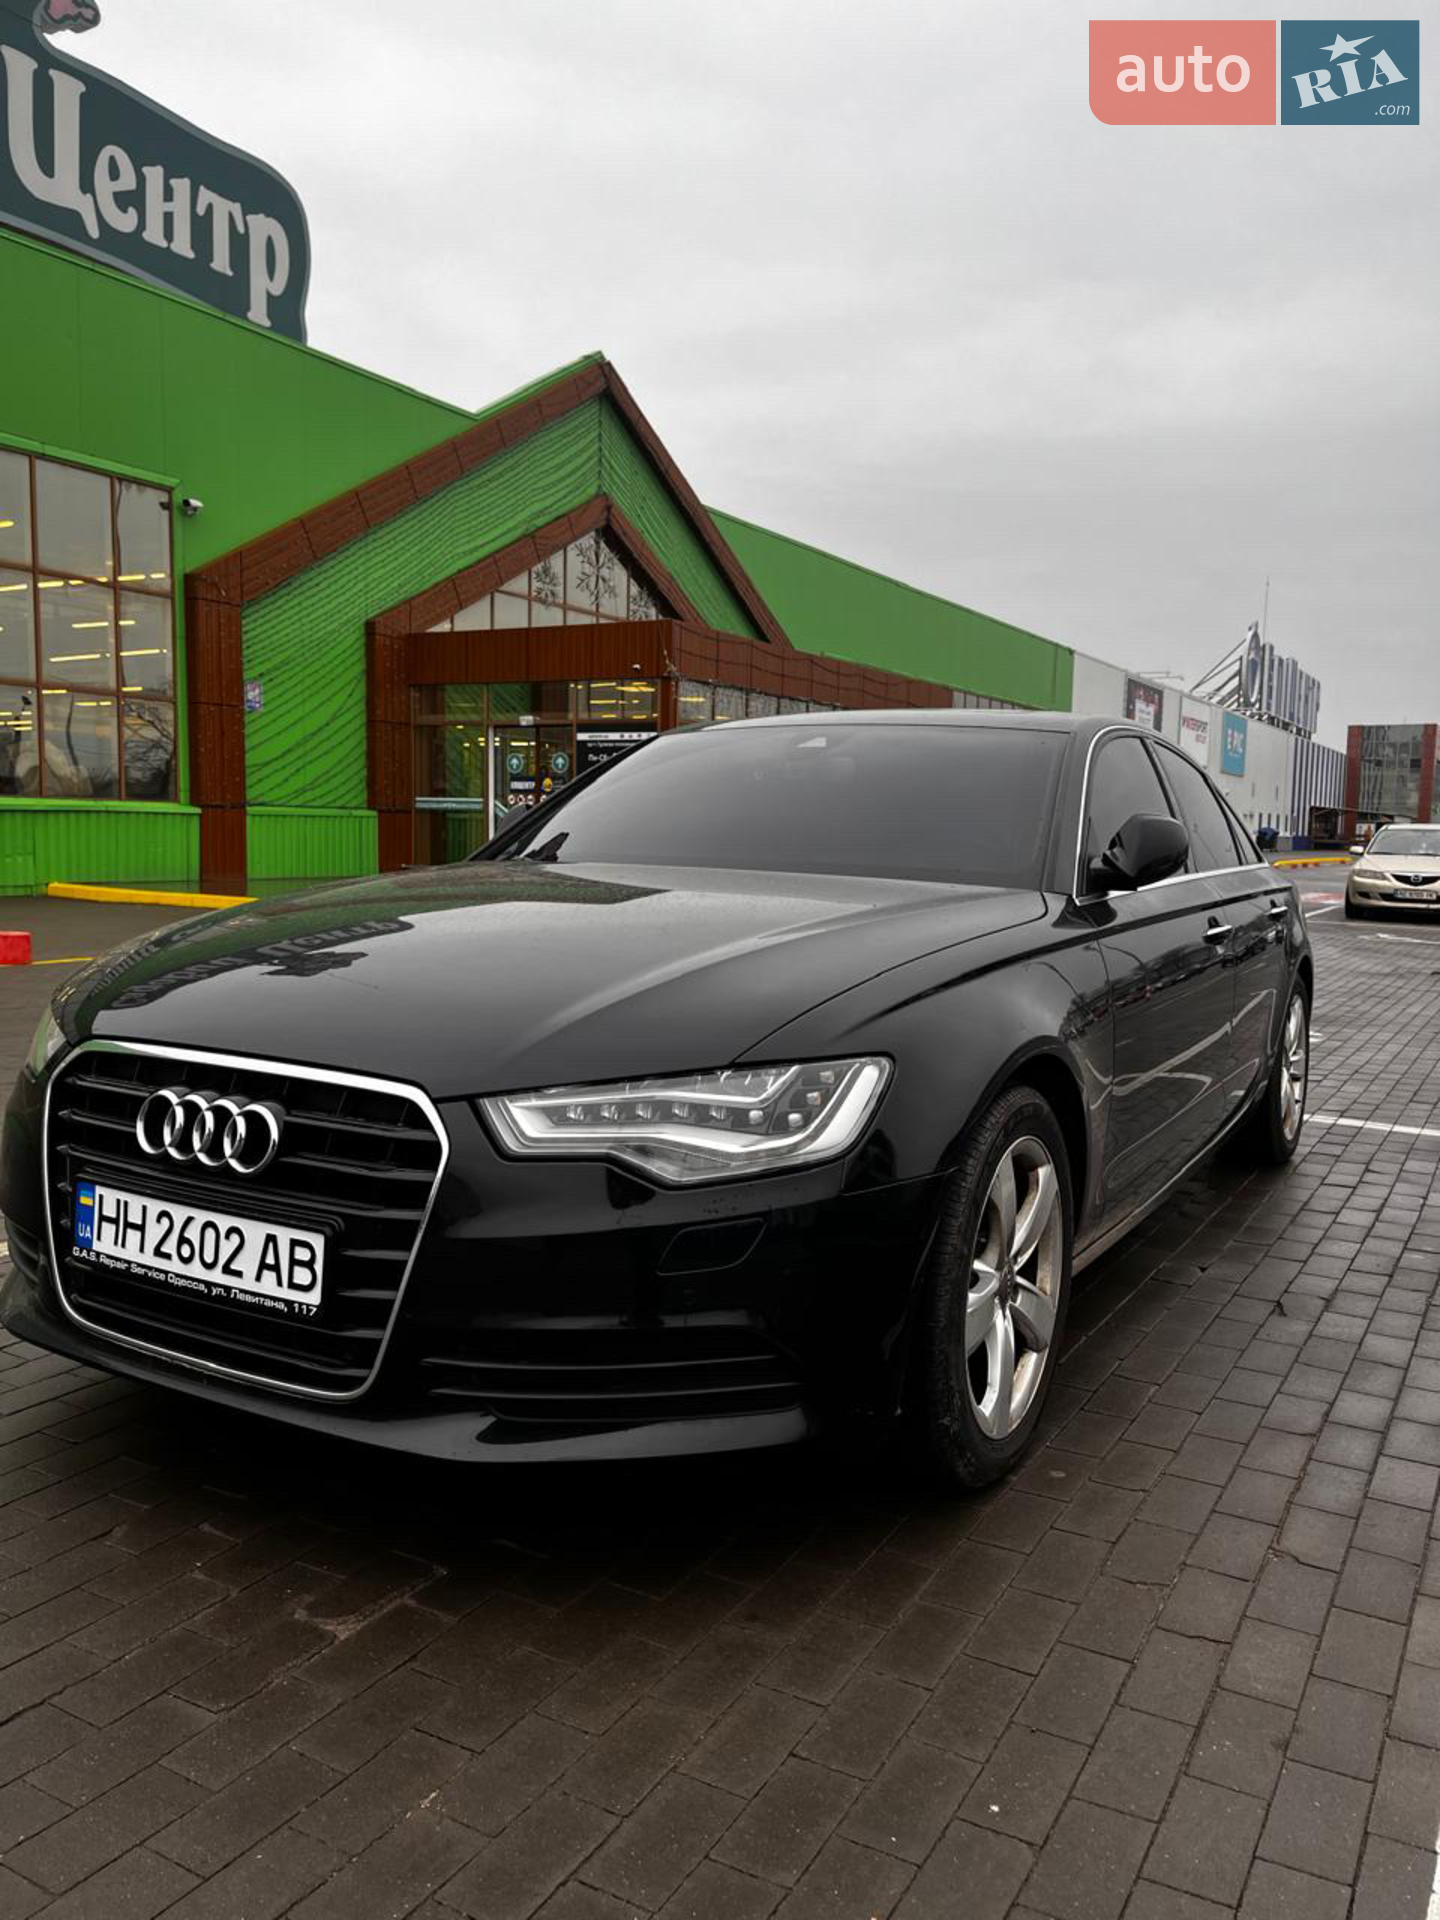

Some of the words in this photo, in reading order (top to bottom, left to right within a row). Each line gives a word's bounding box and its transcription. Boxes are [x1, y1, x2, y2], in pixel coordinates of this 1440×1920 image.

[1, 44, 290, 328] Центр
[77, 1222, 92, 1240] UA
[72, 1246, 98, 1262] G.A.S.
[99, 1254, 129, 1270] Repair
[130, 1263, 166, 1281] Service
[167, 1273, 208, 1294] Одесса,
[211, 1286, 227, 1297] ул.
[230, 1289, 288, 1313] Левитана,
[293, 1302, 318, 1317] 117
